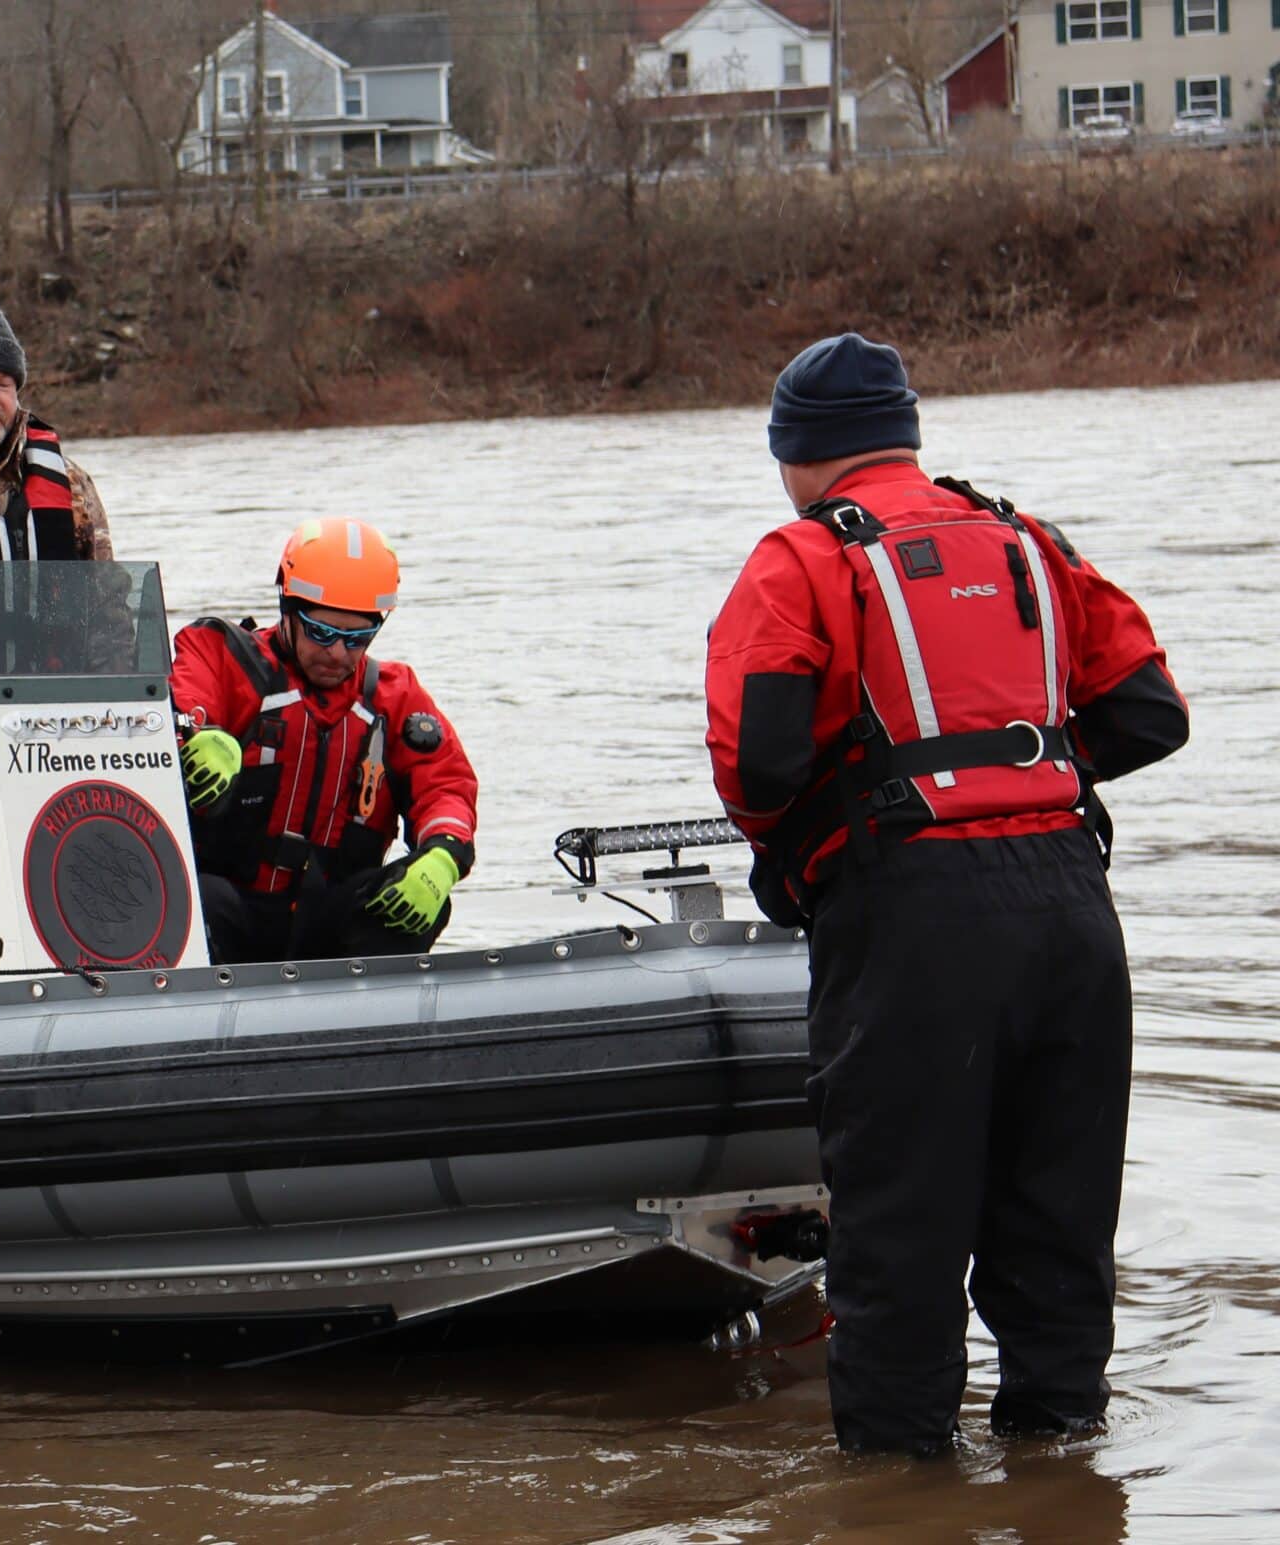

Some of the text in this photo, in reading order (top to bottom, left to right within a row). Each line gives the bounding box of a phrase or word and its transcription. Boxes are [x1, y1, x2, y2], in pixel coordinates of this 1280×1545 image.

[950, 583, 998, 599] NRS
[8, 743, 173, 774] XTReme rescue
[42, 788, 159, 838] RIVER RAPTOR
